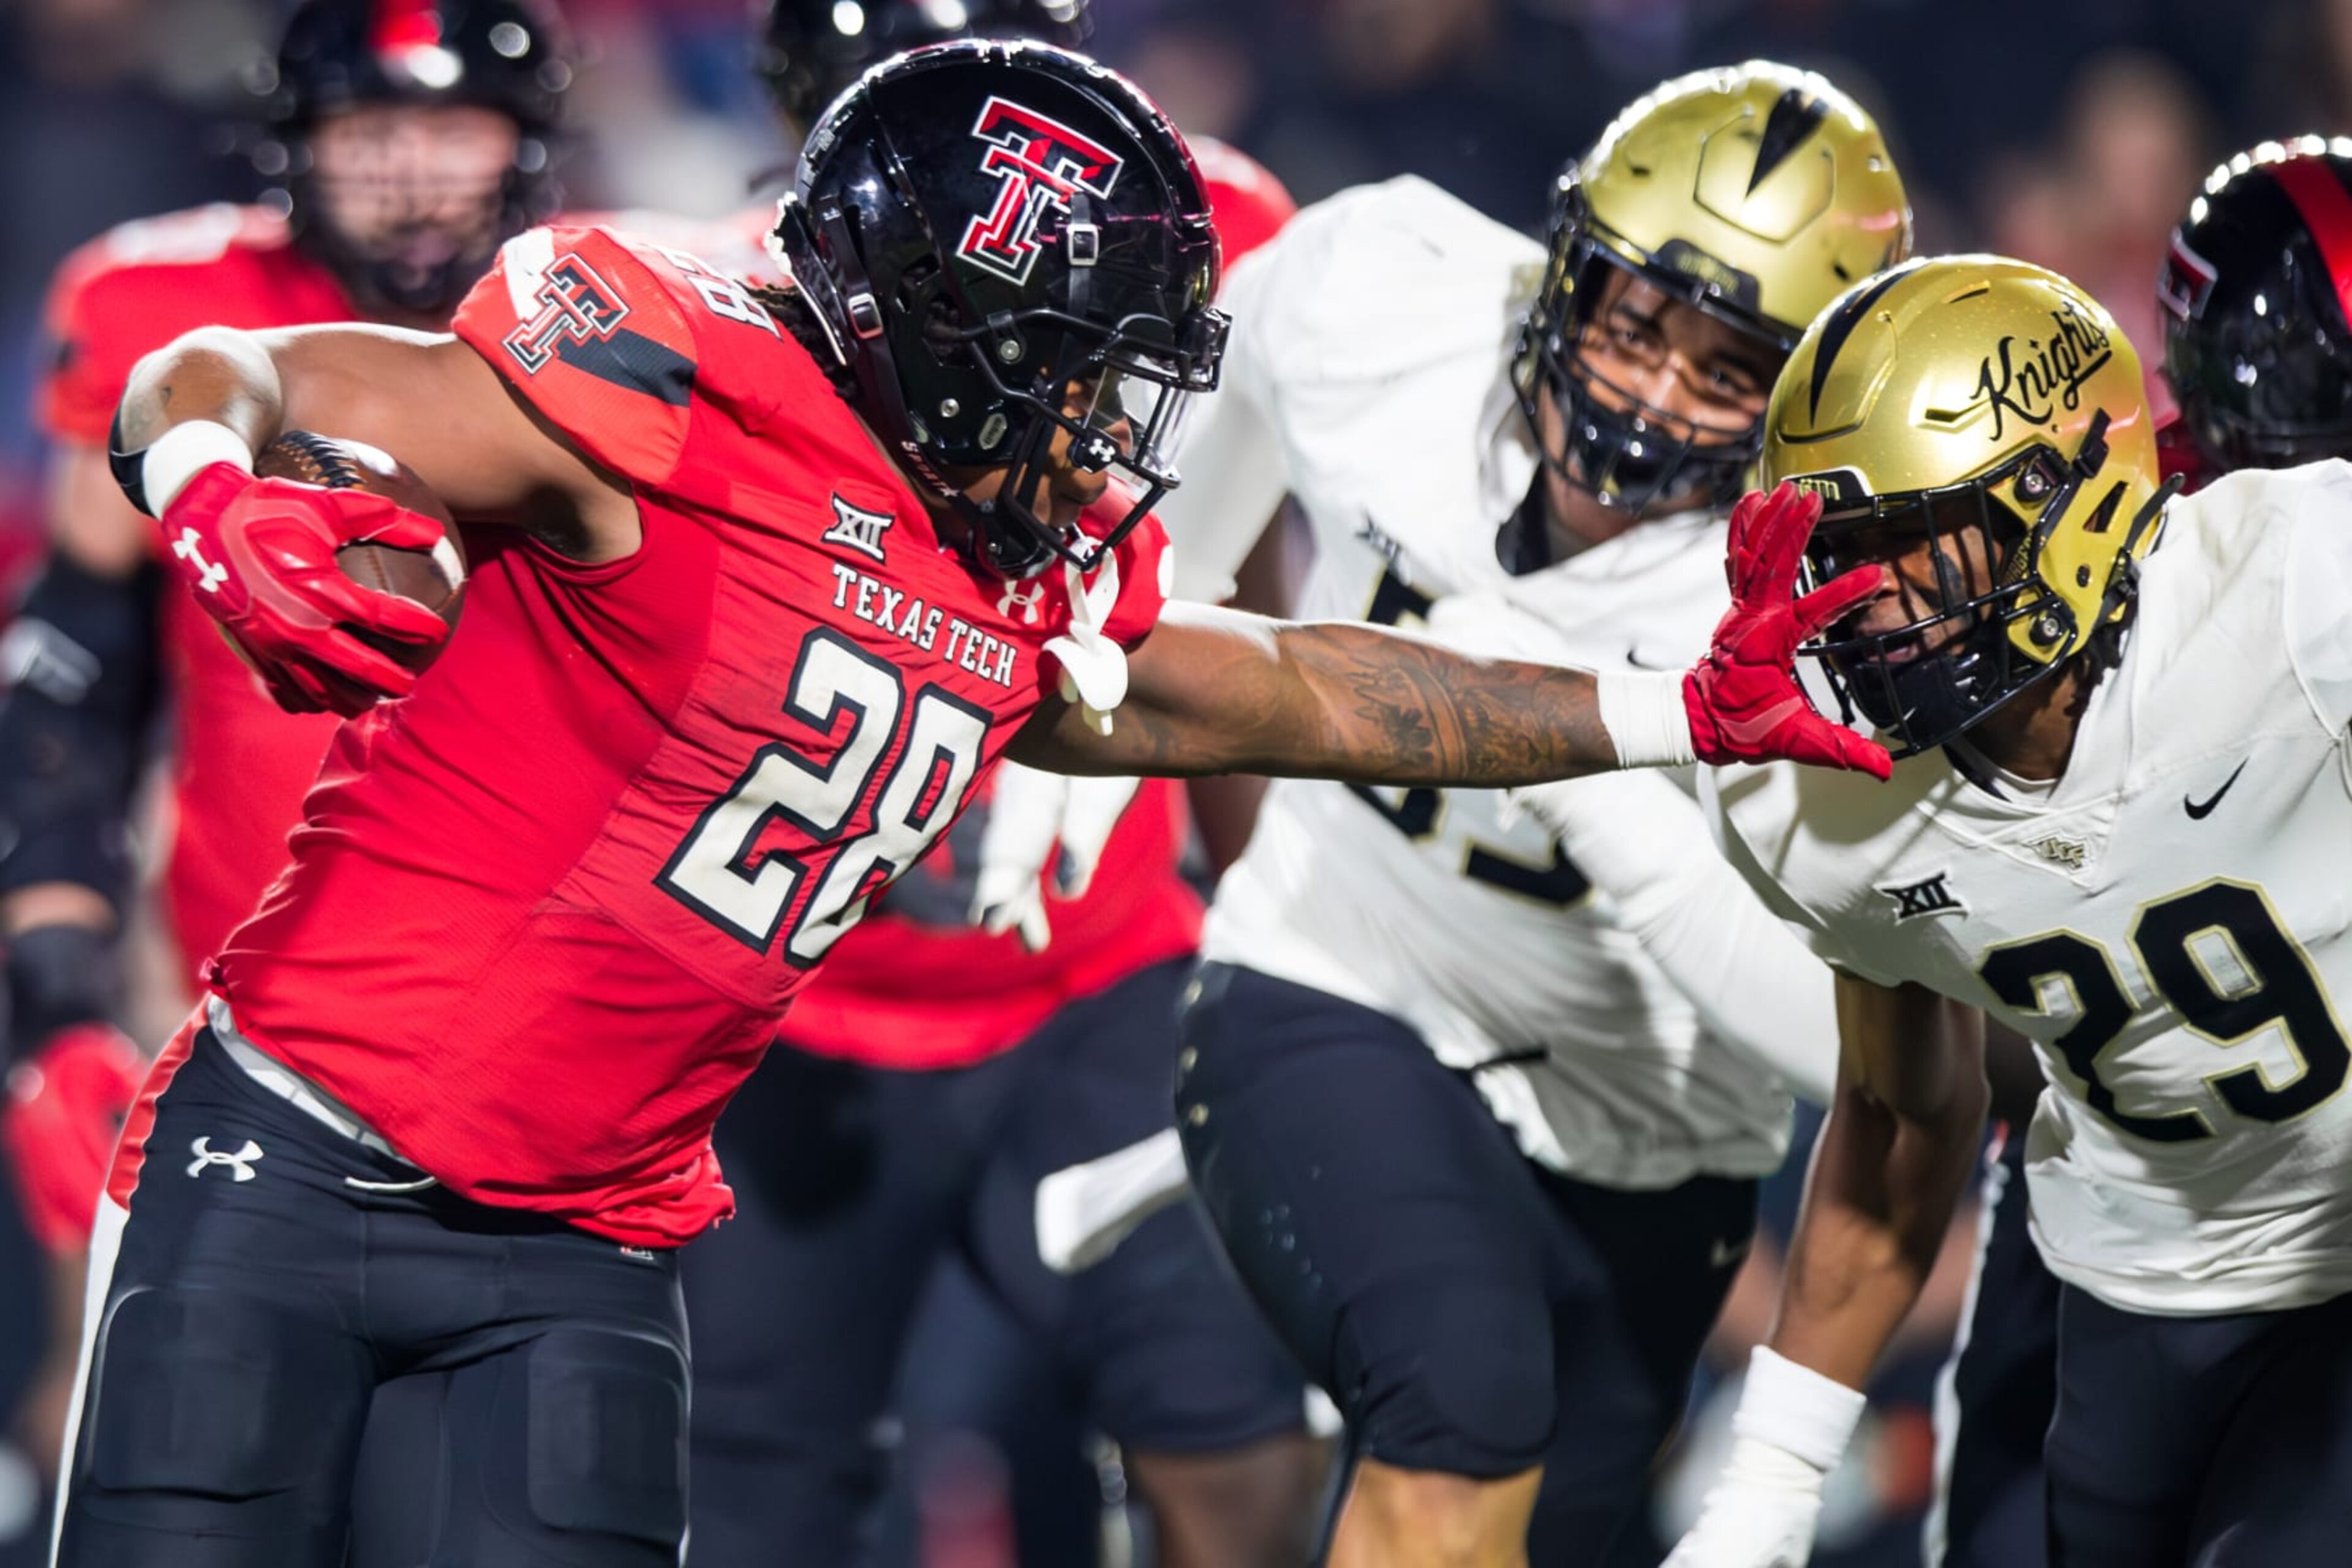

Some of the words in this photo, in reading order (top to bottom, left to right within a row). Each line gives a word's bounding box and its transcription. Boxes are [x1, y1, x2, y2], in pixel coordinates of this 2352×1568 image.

[1969, 301, 2113, 442] Knights
[820, 490, 895, 566] XII
[832, 560, 944, 652] TEXAS
[944, 614, 1017, 688] TECH
[652, 625, 994, 970] 28
[1881, 869, 1963, 919] XII
[1976, 875, 2352, 1143] 29
